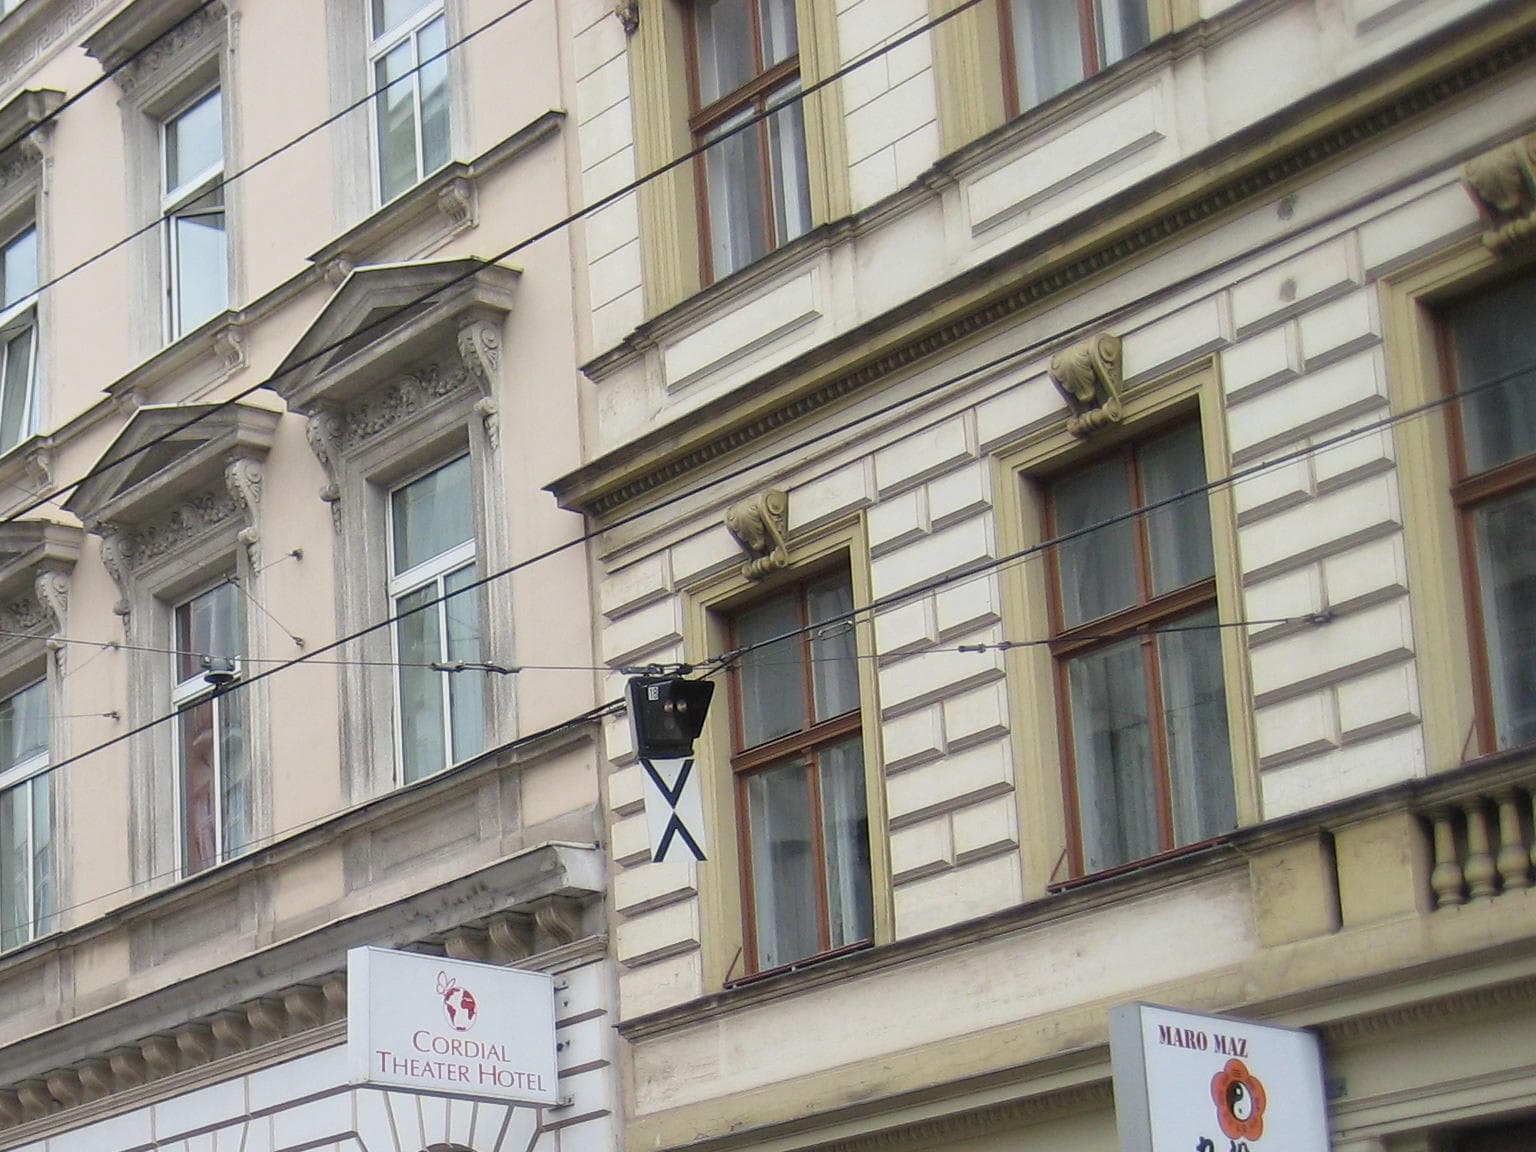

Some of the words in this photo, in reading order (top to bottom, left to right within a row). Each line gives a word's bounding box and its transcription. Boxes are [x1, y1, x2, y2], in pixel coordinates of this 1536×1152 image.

[413, 1030, 511, 1063] CORDIAL
[1158, 1024, 1208, 1051] MARO
[1213, 1034, 1249, 1058] MAZ
[376, 1050, 471, 1083] THEATER
[478, 1063, 546, 1092] HOTEL
